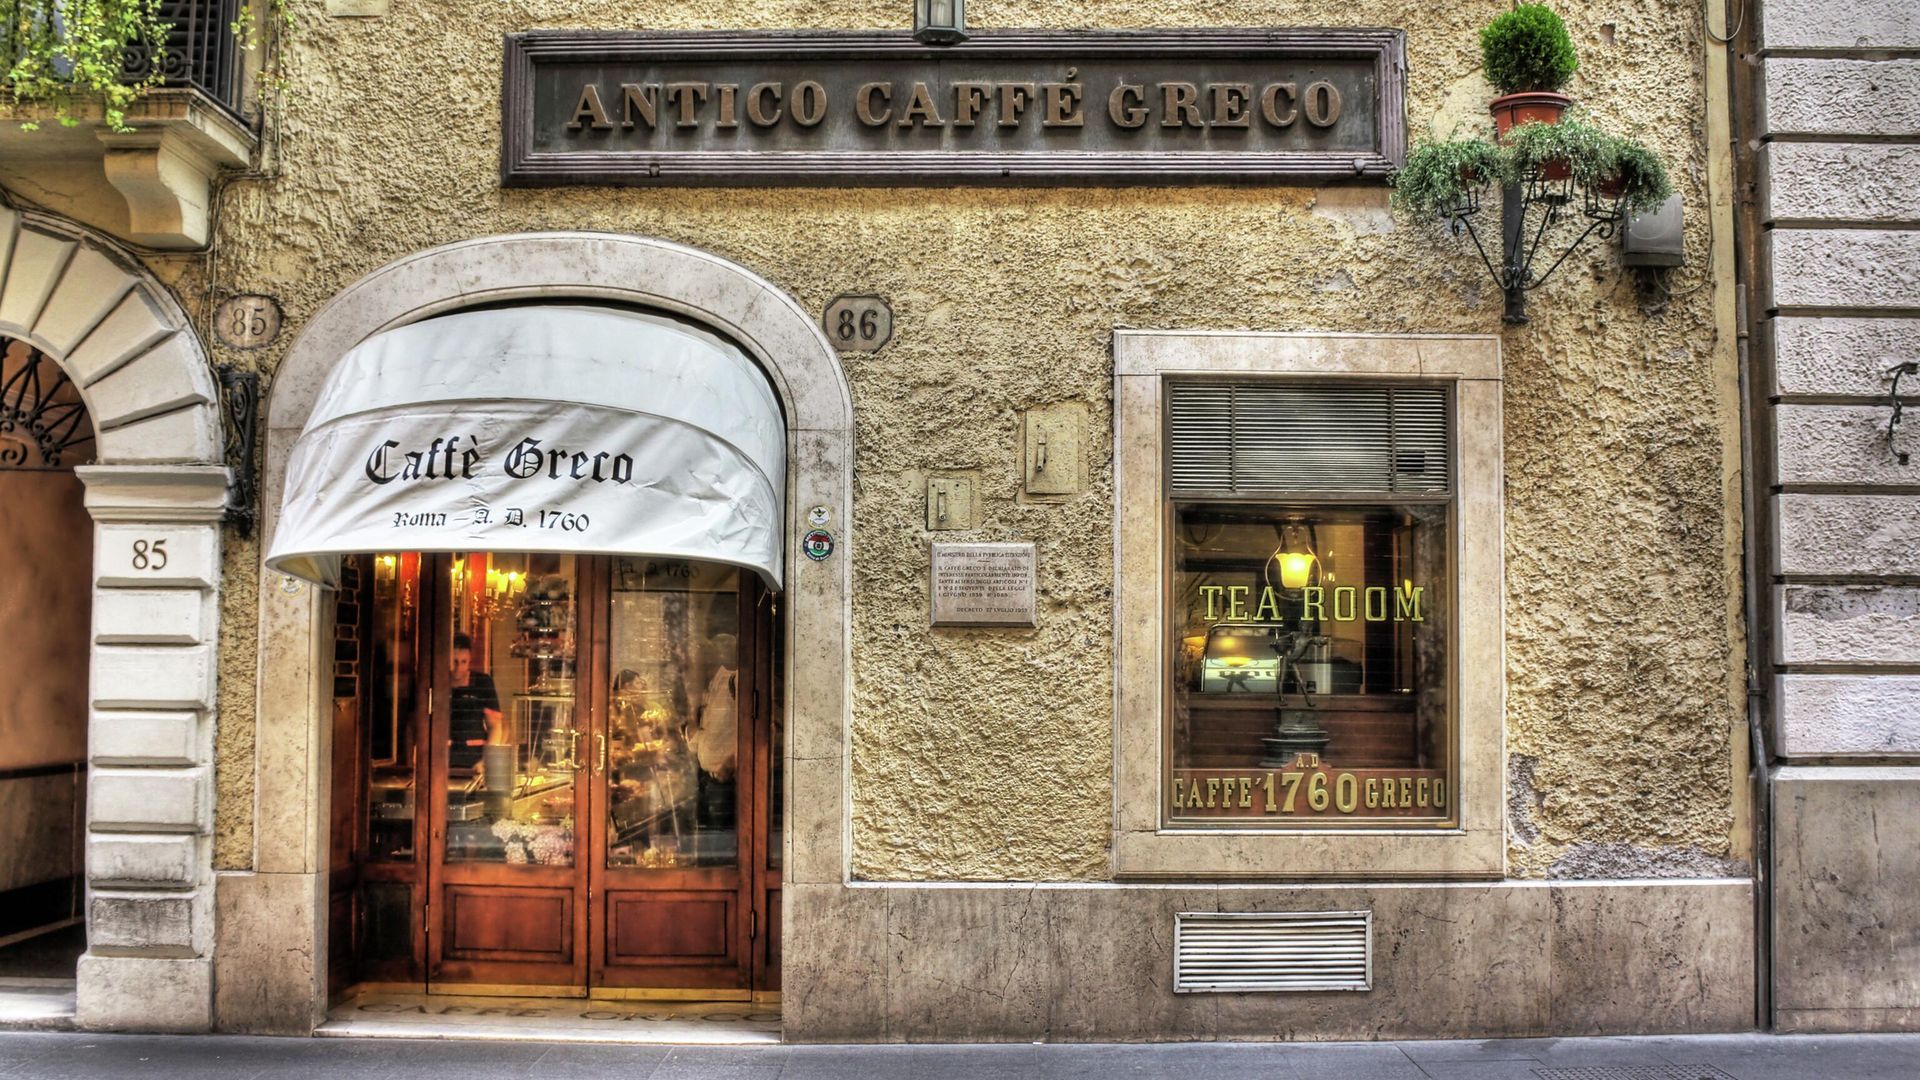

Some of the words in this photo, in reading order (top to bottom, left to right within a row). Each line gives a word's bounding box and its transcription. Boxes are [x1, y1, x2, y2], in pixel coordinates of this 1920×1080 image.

[566, 80, 827, 129] ANTICO
[1107, 80, 1342, 128] GRECO
[232, 307, 267, 337] 85
[838, 308, 879, 341] 86
[365, 435, 481, 485] Caffè
[503, 436, 634, 485] Greco
[392, 511, 447, 529] Roma
[539, 509, 591, 533] 1760
[132, 538, 168, 570] 85
[1199, 585, 1284, 621] TEA
[1300, 585, 1425, 622] ROOM
[1263, 771, 1358, 813] 1760
[1365, 777, 1447, 809] GRECO
